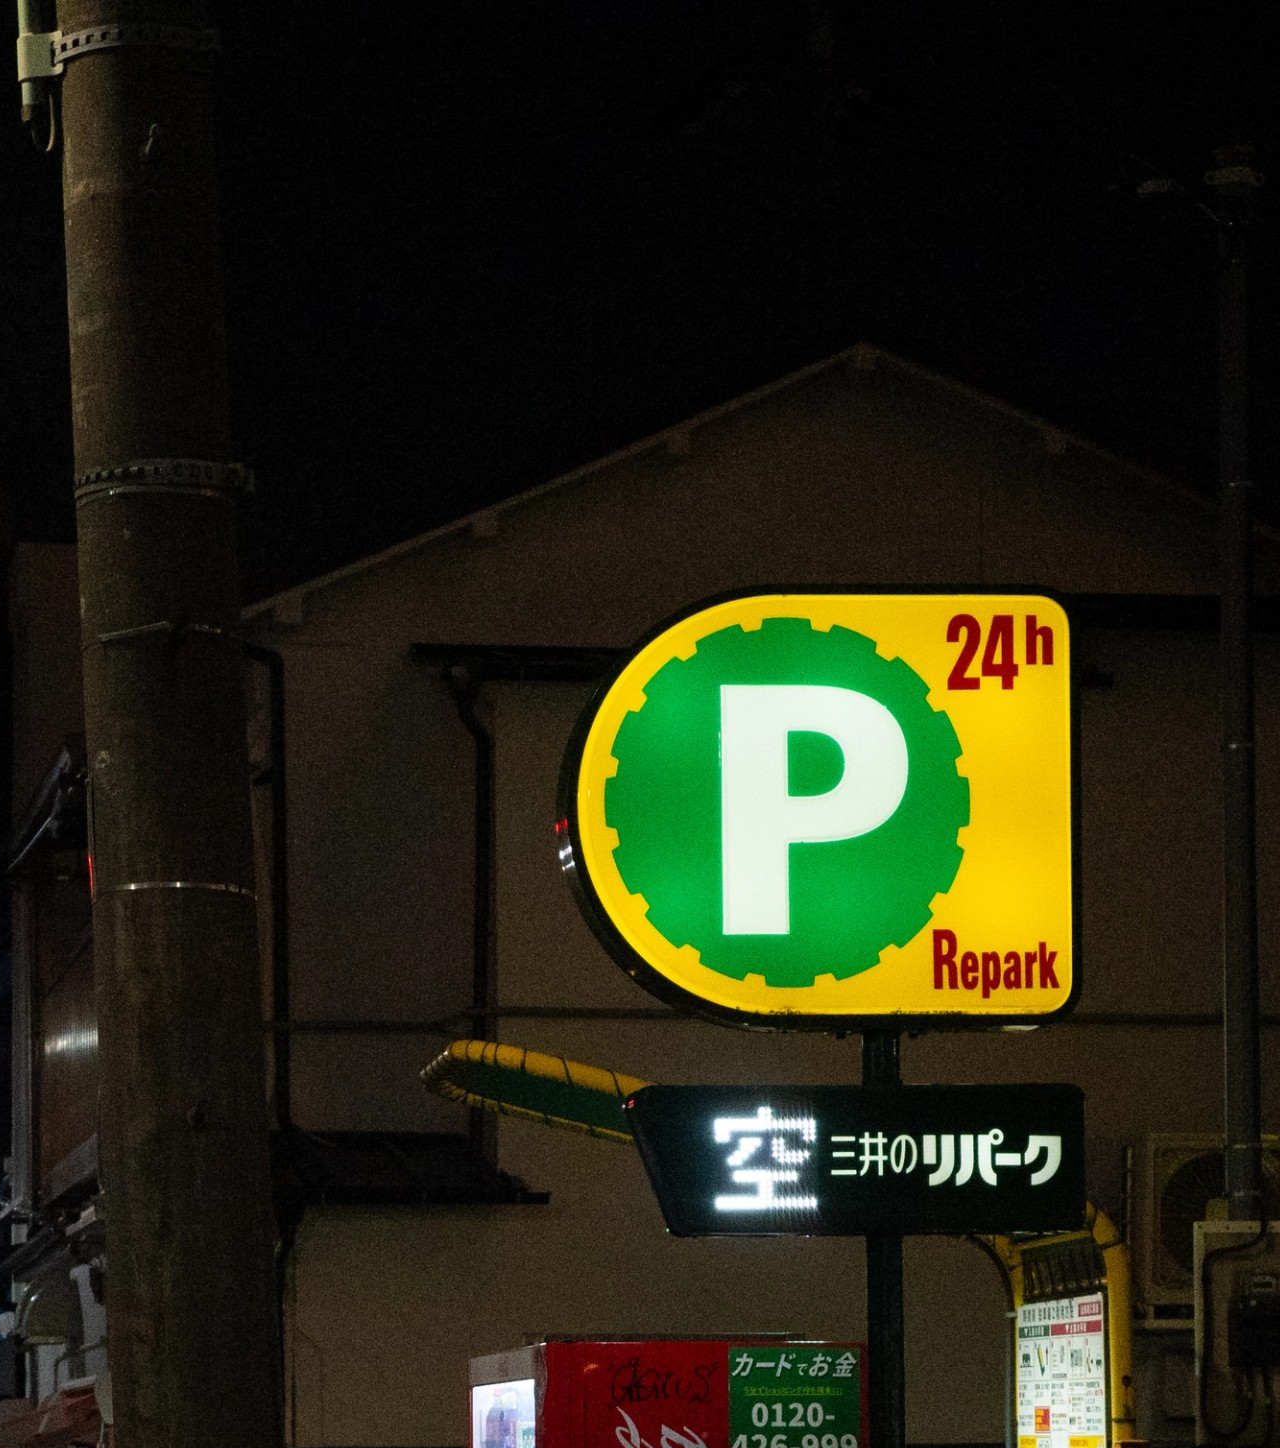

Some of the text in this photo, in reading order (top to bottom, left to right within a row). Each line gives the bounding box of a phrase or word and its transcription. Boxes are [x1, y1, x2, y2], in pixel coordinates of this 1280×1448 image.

[946, 613, 1055, 690] 24h
[720, 684, 909, 936] P
[933, 929, 1061, 1000] Repark
[714, 1104, 818, 1212] 空
[830, 1127, 1063, 1187] 三井のリパーク
[731, 1351, 858, 1379] カードでお金
[751, 1401, 836, 1429] 0120-
